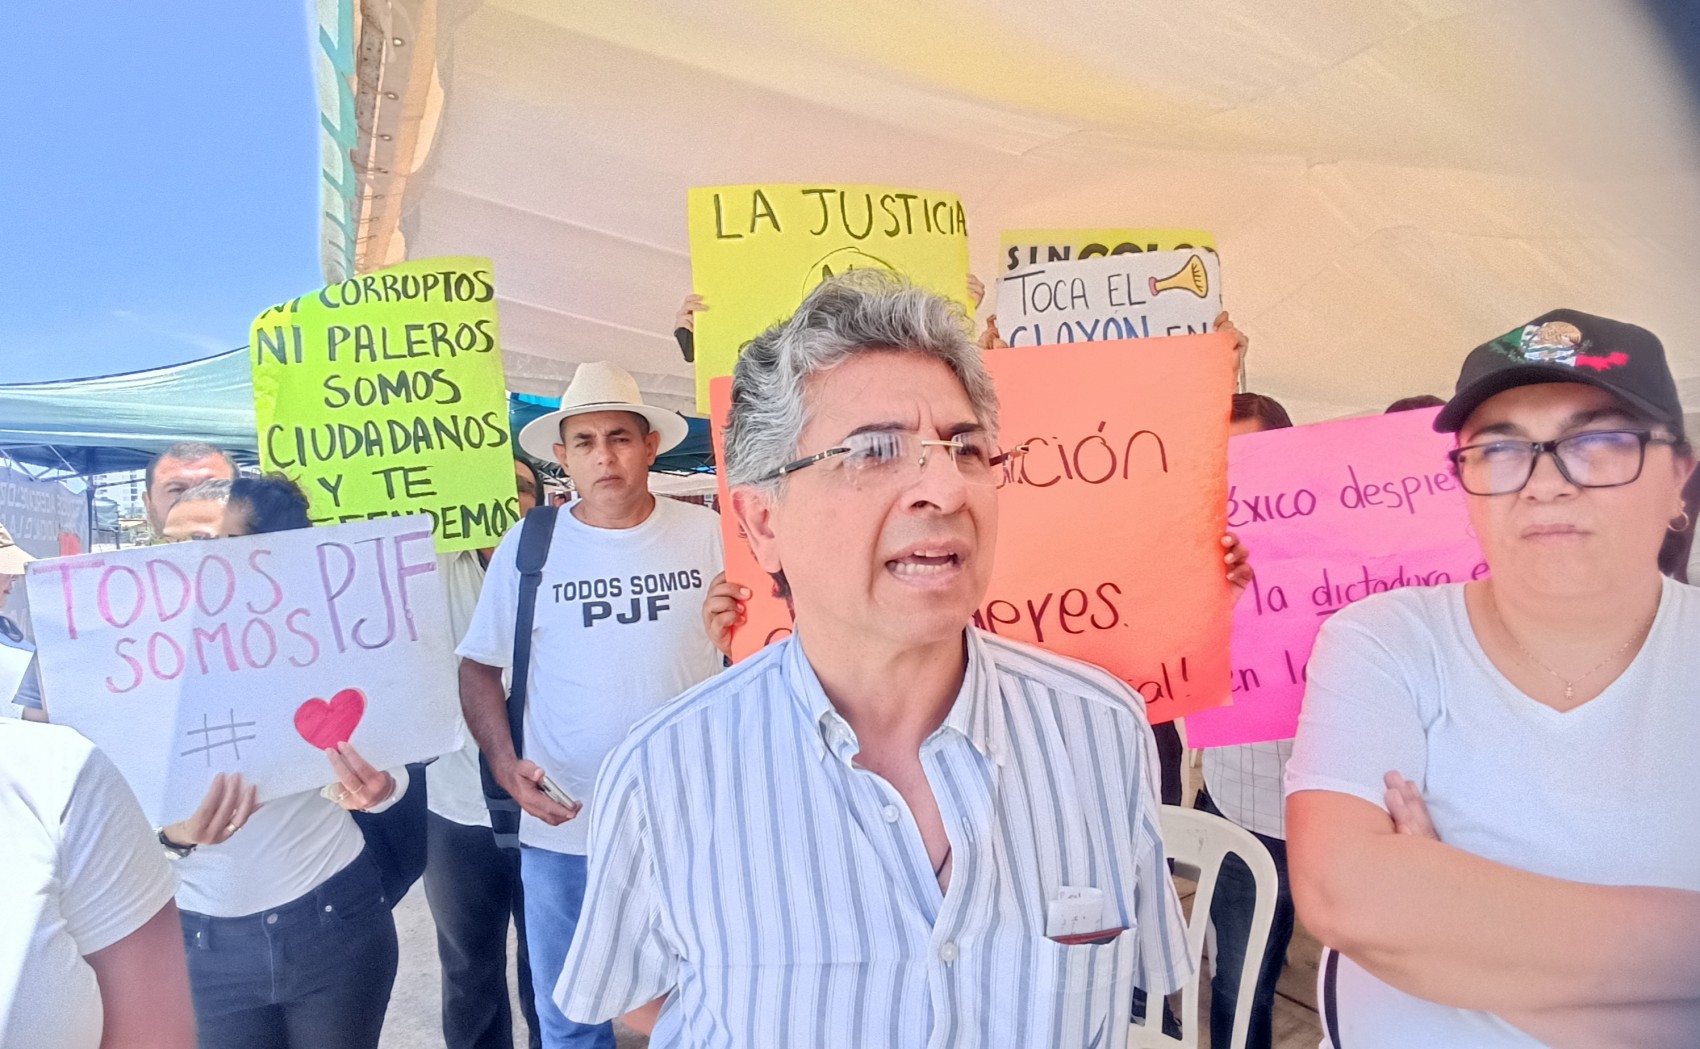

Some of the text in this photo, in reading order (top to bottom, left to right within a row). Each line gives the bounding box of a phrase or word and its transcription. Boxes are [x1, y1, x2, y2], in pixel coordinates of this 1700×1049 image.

[713, 188, 968, 240] LA JUSTICIA
[319, 270, 495, 309] CORRUPTOS
[1003, 270, 1147, 316] TOCA EL
[256, 319, 495, 365] NI PALEROS
[322, 368, 462, 408] SOMOS
[266, 411, 509, 469] CIUDADANOS
[316, 465, 438, 507] Y TE
[1227, 464, 1456, 527] éxico despie
[32, 530, 437, 653] TODOS PJF
[552, 569, 703, 603] TODOS SOMOS
[1251, 568, 1289, 616] la
[582, 594, 671, 628] PJF
[105, 607, 321, 694] SOMOS
